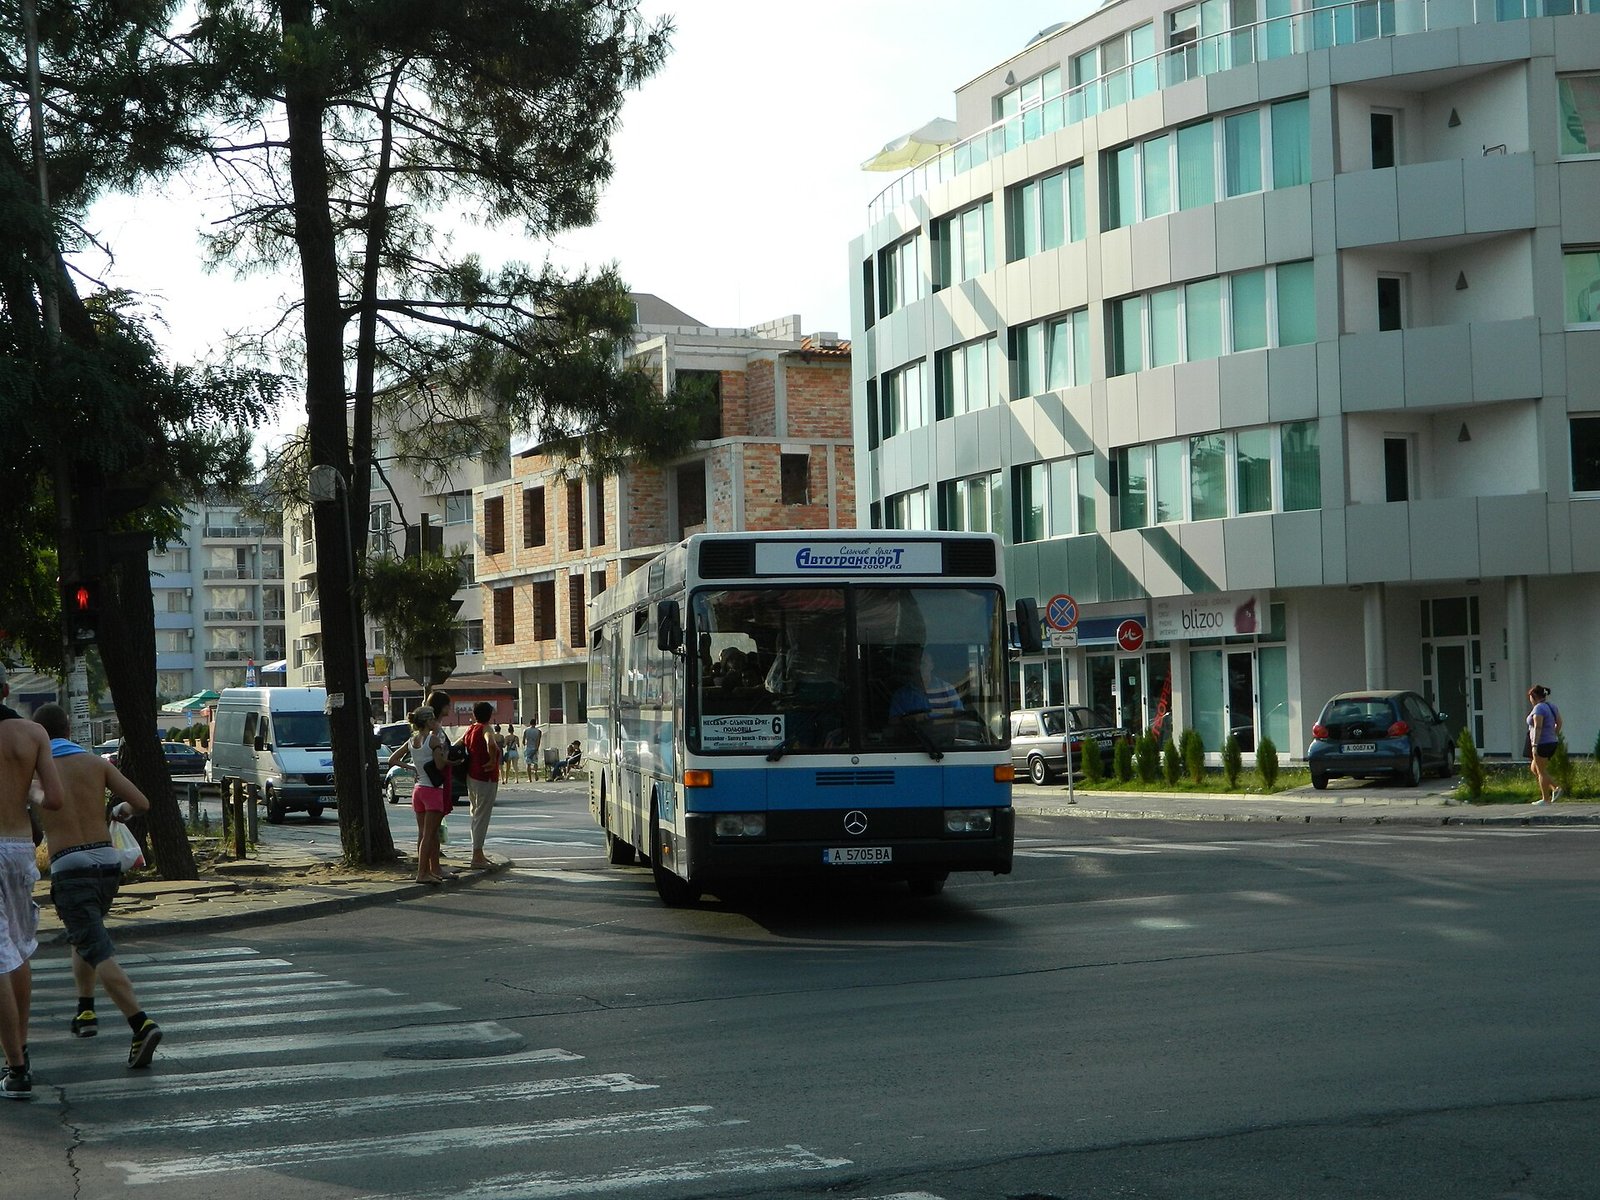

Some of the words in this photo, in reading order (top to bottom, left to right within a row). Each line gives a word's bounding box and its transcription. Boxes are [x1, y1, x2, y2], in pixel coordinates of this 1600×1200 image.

[1181, 608, 1224, 630] blizoo
[771, 716, 782, 734] 6
[834, 849, 842, 861] A
[846, 849, 874, 860] 5705
[875, 848, 890, 860] BA
